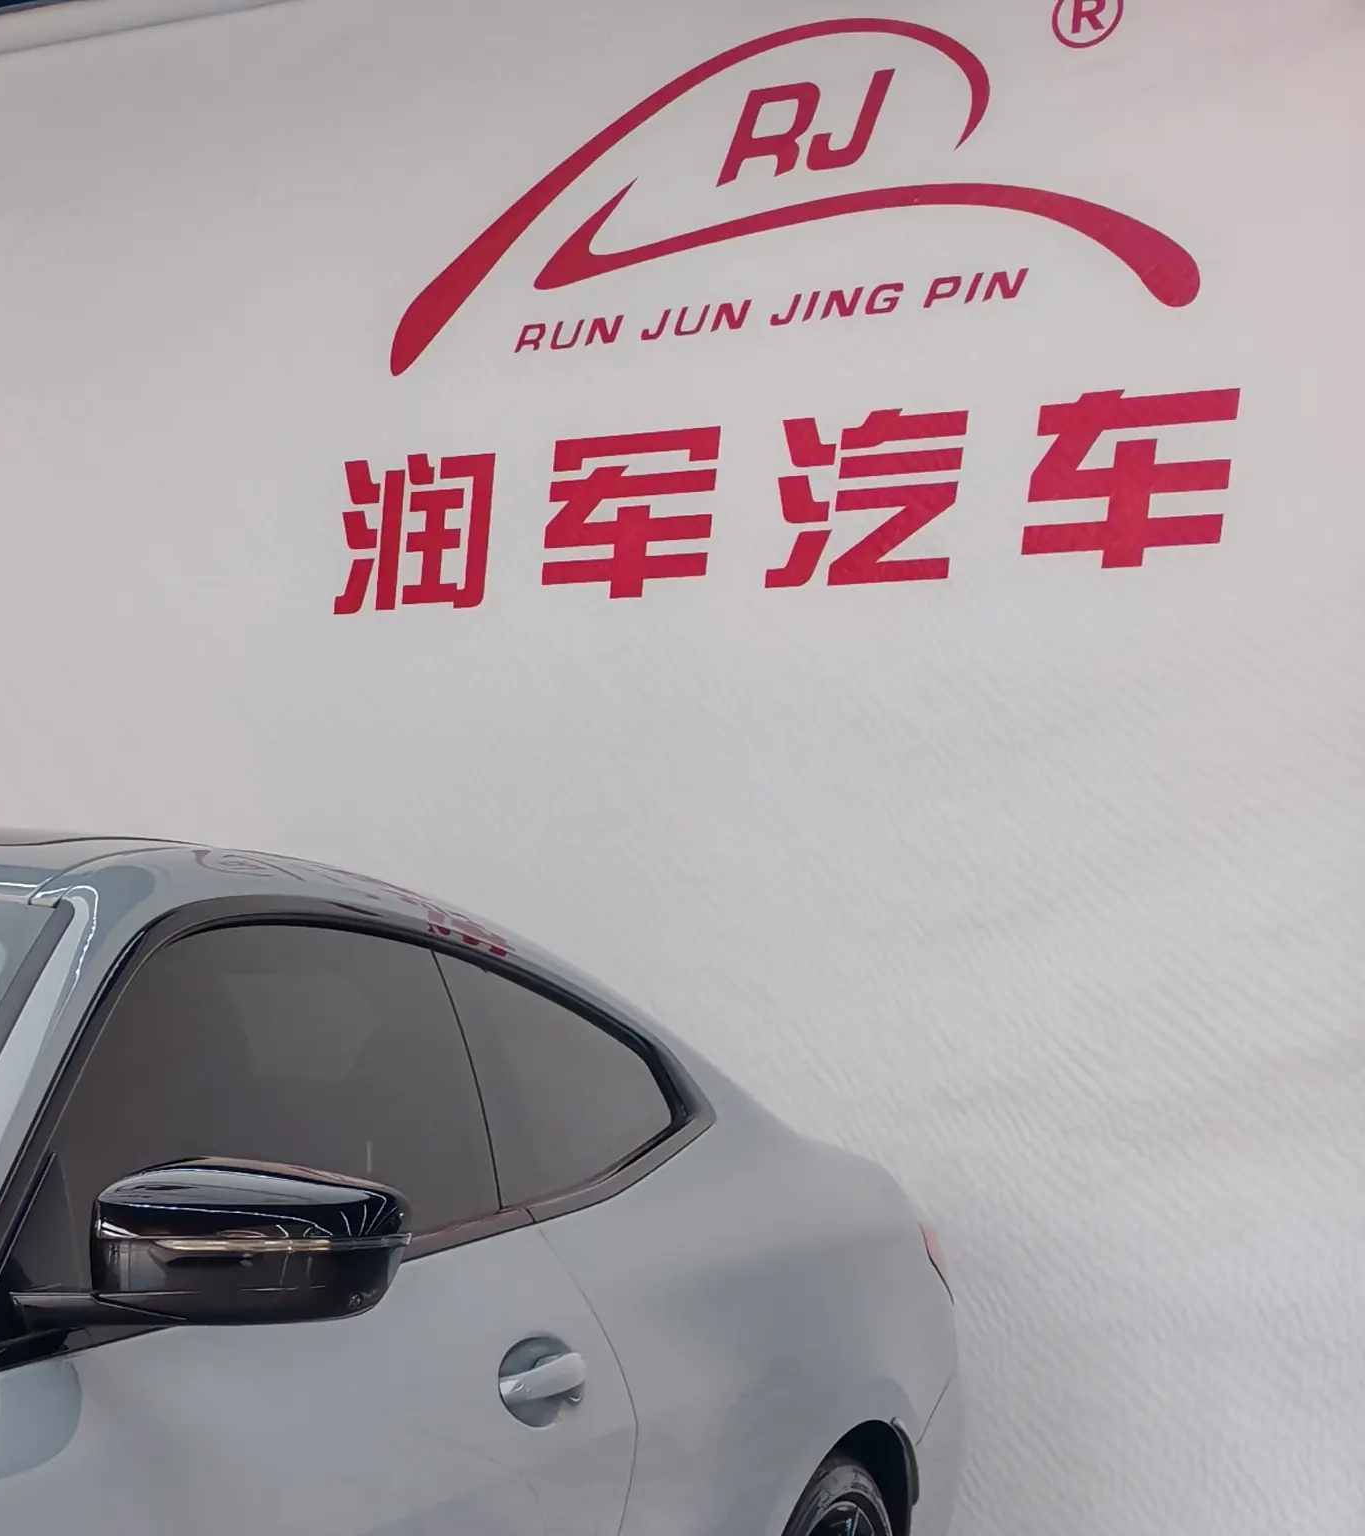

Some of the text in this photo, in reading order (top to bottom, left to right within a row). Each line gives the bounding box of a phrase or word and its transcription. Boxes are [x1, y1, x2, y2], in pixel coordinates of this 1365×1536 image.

[716, 68, 896, 188] RJ
[513, 267, 1030, 353] RUN JUN JING PIN
[333, 387, 1242, 616] 润军汽车
